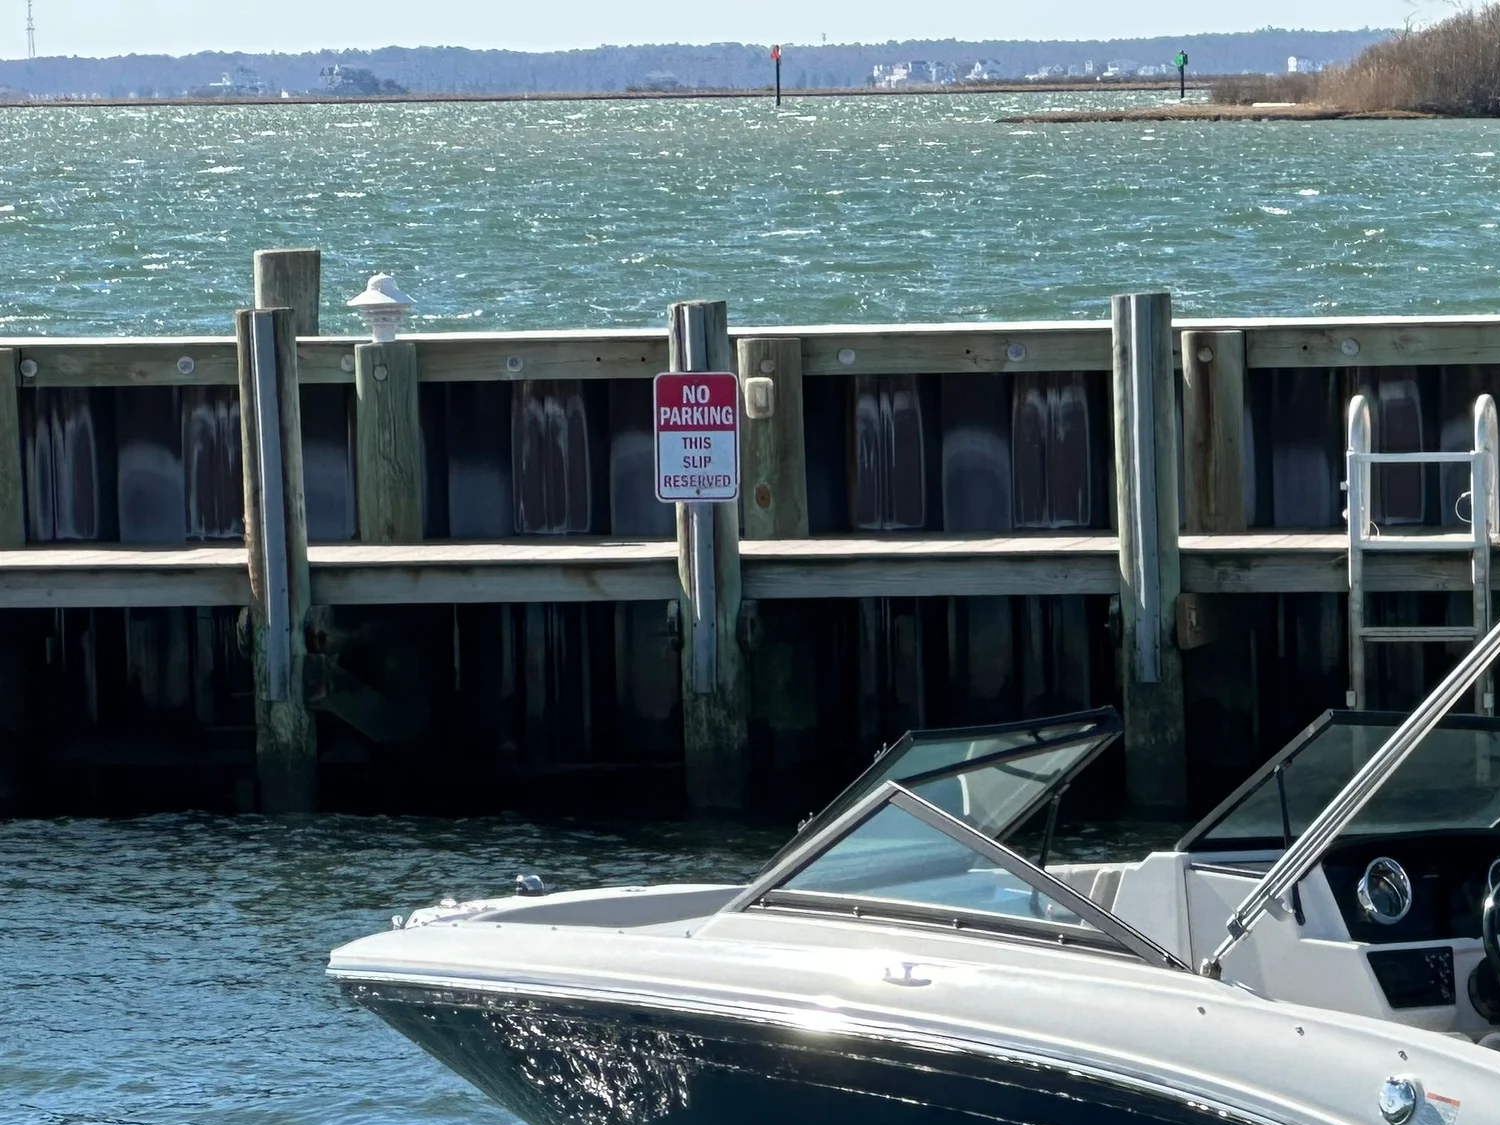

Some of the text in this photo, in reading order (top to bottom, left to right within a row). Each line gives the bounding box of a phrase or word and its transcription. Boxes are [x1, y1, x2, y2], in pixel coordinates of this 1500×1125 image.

[682, 385, 710, 404] NO
[660, 406, 734, 426] PARKING
[682, 436, 712, 450] THIS
[683, 456, 712, 469] SLIP
[664, 474, 731, 488] RESERVED
